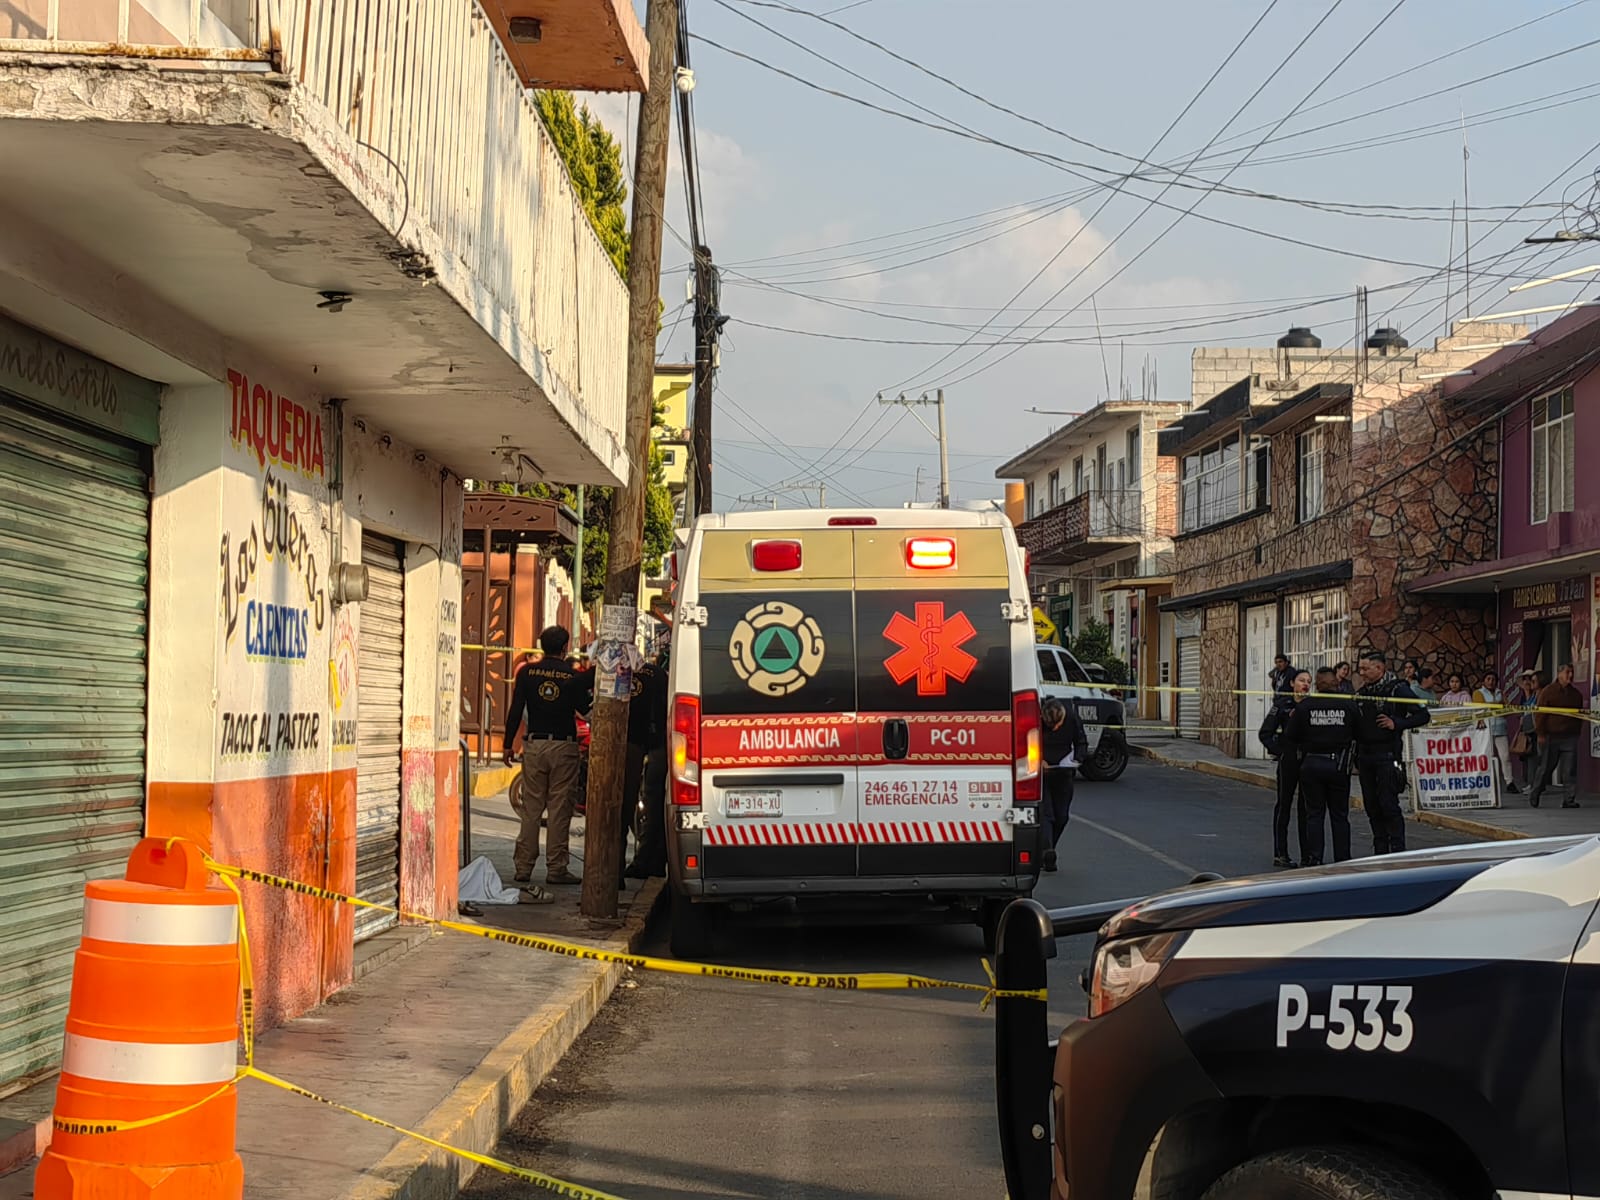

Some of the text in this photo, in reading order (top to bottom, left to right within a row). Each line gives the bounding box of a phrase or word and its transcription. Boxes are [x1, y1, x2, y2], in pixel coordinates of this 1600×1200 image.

[227, 368, 324, 475] TAQUERIA
[246, 599, 309, 660] CARNITAS
[1310, 710, 1345, 718] VIALIDAD
[1310, 718, 1345, 726] MUNICIPAL
[220, 713, 257, 756] TACOS
[257, 713, 272, 753] AL
[276, 712, 320, 751] PASTOR
[739, 727, 840, 750] AMBULANCIA
[930, 728, 976, 746] PC-01
[1426, 736, 1472, 755] POLLO
[1416, 754, 1489, 775] SUPREMO
[864, 780, 958, 793] 246 46 1 27 14
[969, 782, 1002, 793] 911
[1419, 775, 1491, 791] 100% FRESCO
[864, 793, 959, 806] EMERGENCIAS
[816, 976, 859, 989] PASO
[1276, 983, 1414, 1053] P-533
